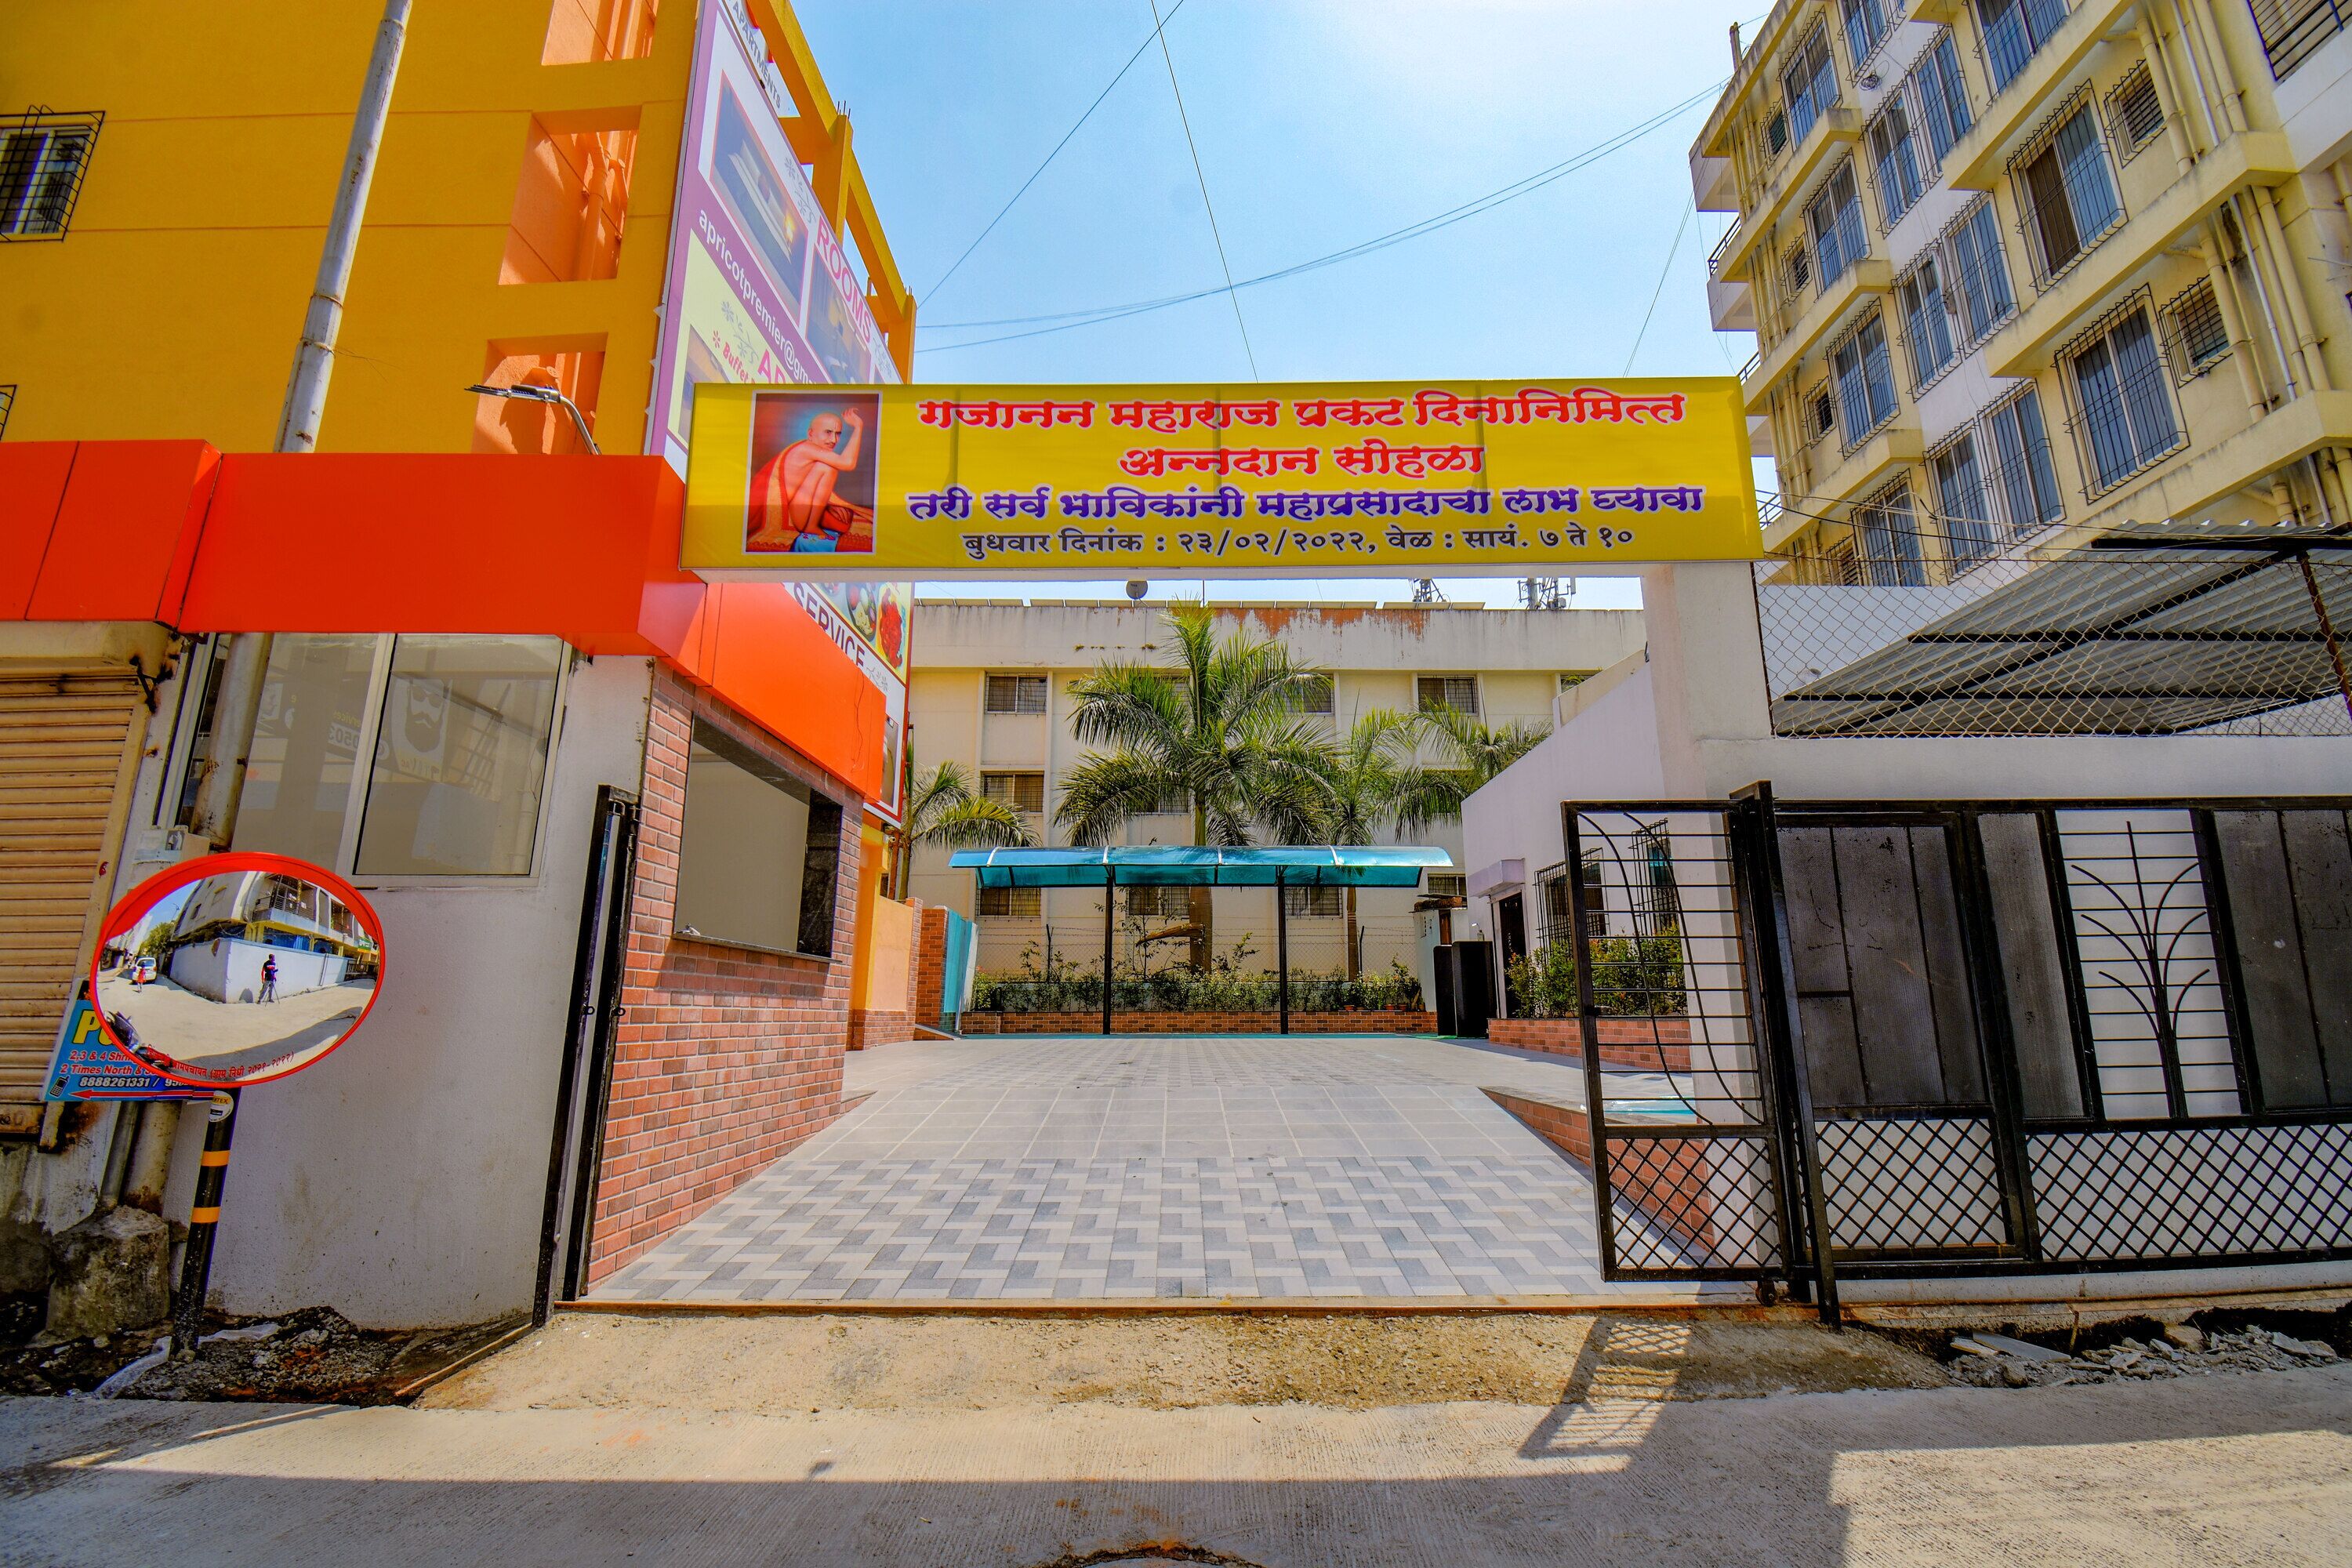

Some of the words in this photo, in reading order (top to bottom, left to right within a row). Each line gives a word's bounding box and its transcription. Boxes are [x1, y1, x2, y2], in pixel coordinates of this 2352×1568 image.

[733, 2, 782, 109] APARTMENTS
[699, 209, 817, 384] apricotpremier@gm
[816, 215, 872, 344] ROOMS
[919, 401, 1095, 429] गजानन
[1109, 401, 1280, 433] महाराज
[1294, 398, 1405, 427] प्रकट
[1413, 388, 1685, 426] दिनानिमित्त
[1120, 448, 1319, 476] अन्नदान
[1333, 438, 1484, 478] सोहळा
[908, 486, 973, 519] तरी
[984, 486, 1051, 519] सर्व
[1060, 486, 1244, 518] भाविकांनी
[1256, 489, 1490, 521] महाप्रसादाचा
[1502, 488, 1579, 513] लाभ
[1591, 487, 1703, 512] घ्यावा
[963, 534, 1051, 560] बुधवार
[1058, 527, 1142, 553] दिनांक
[1179, 529, 1375, 556] २३/०२/२०२२,
[1385, 524, 1432, 549] वेळ
[1462, 523, 1528, 547] सायं.
[1540, 530, 1559, 547] ७
[1566, 521, 1587, 547] ते
[1599, 527, 1633, 548] १०
[60, 1065, 68, 1074] 2
[71, 1065, 101, 1075] Times
[103, 1065, 132, 1075] North
[89, 1051, 97, 1061] &
[100, 1051, 107, 1061] 4
[80, 1077, 151, 1087] 8888261331
